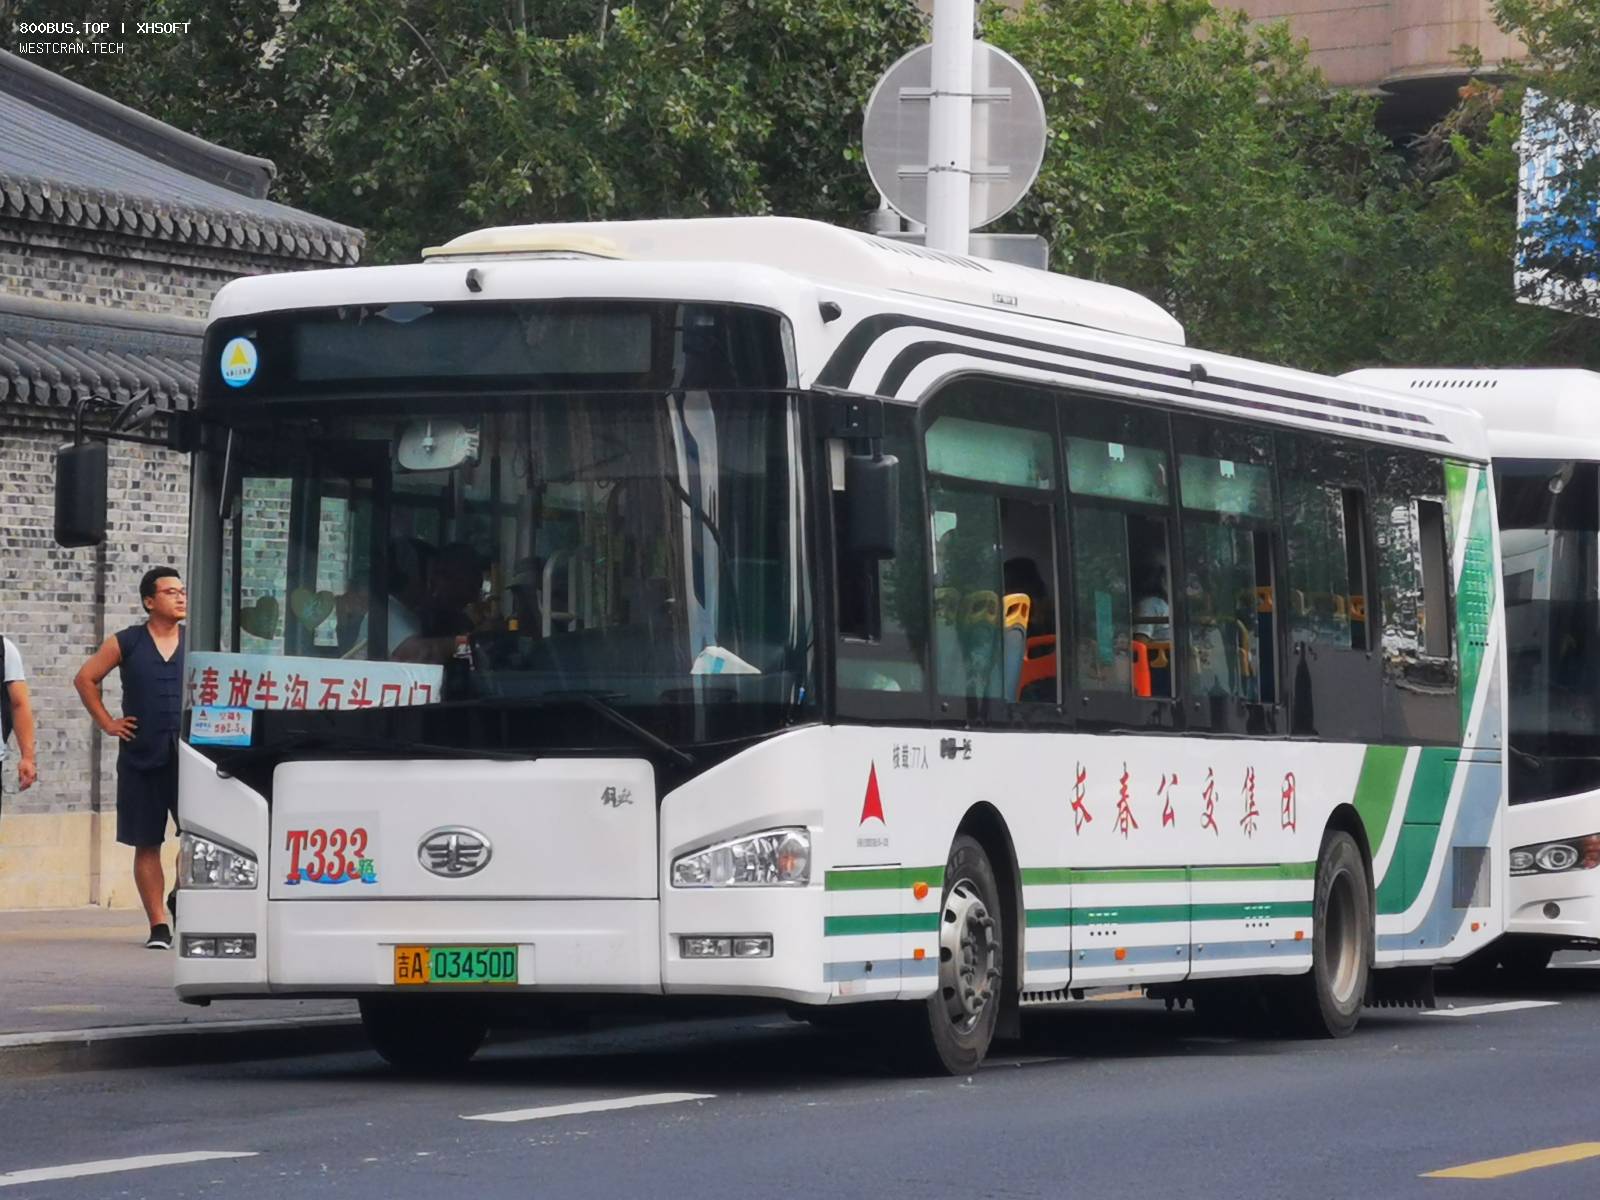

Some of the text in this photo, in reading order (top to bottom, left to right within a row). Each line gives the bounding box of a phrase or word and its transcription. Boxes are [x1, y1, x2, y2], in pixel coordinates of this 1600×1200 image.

[1070, 760, 1297, 840] 长春公交集团
